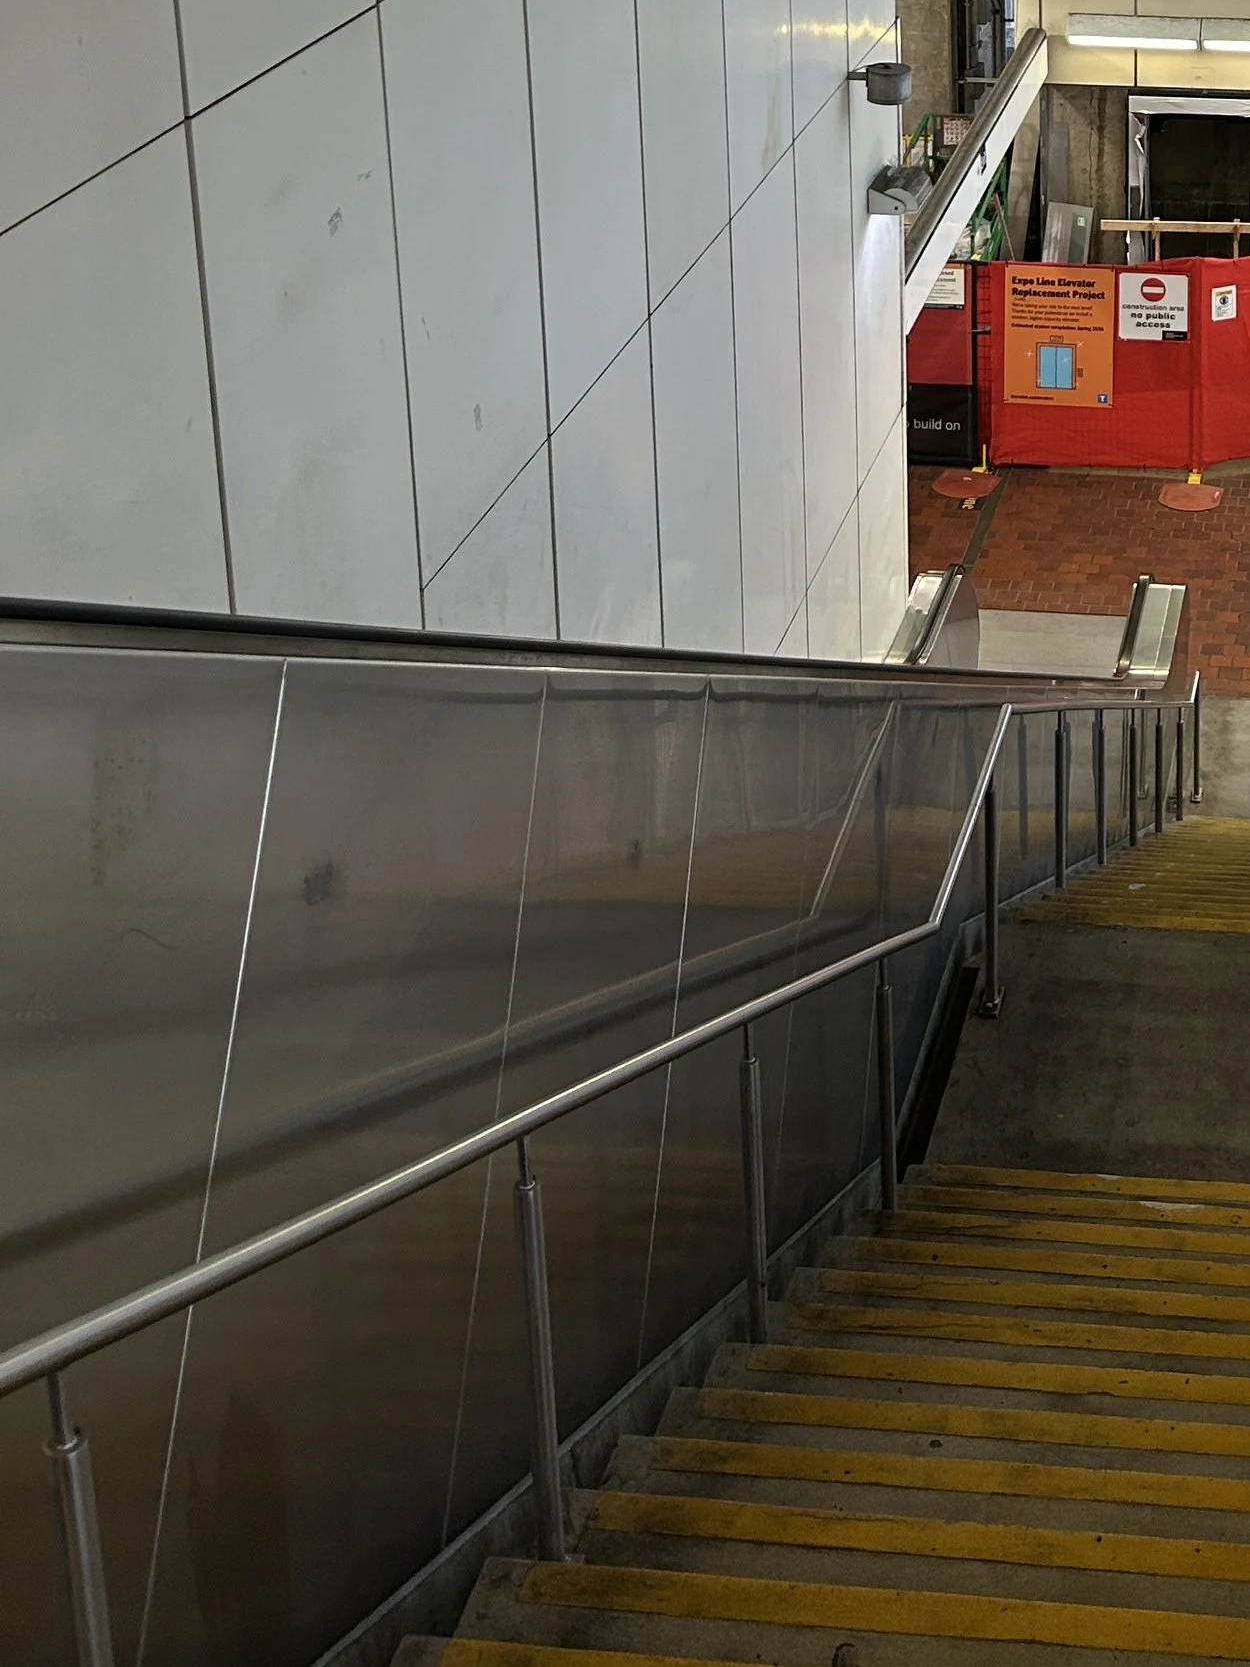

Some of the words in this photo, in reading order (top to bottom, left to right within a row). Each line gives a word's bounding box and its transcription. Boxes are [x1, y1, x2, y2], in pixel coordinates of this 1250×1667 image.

[1011, 276, 1034, 287] Expo
[1036, 277, 1056, 287] Line
[1057, 278, 1097, 288] Elevator
[1012, 288, 1071, 298] Replacement
[1072, 290, 1105, 300] Project
[1122, 303, 1168, 311] construction
[1145, 312, 1176, 321] public
[1135, 320, 1171, 329] access
[913, 418, 942, 431] build
[945, 420, 961, 431] on
